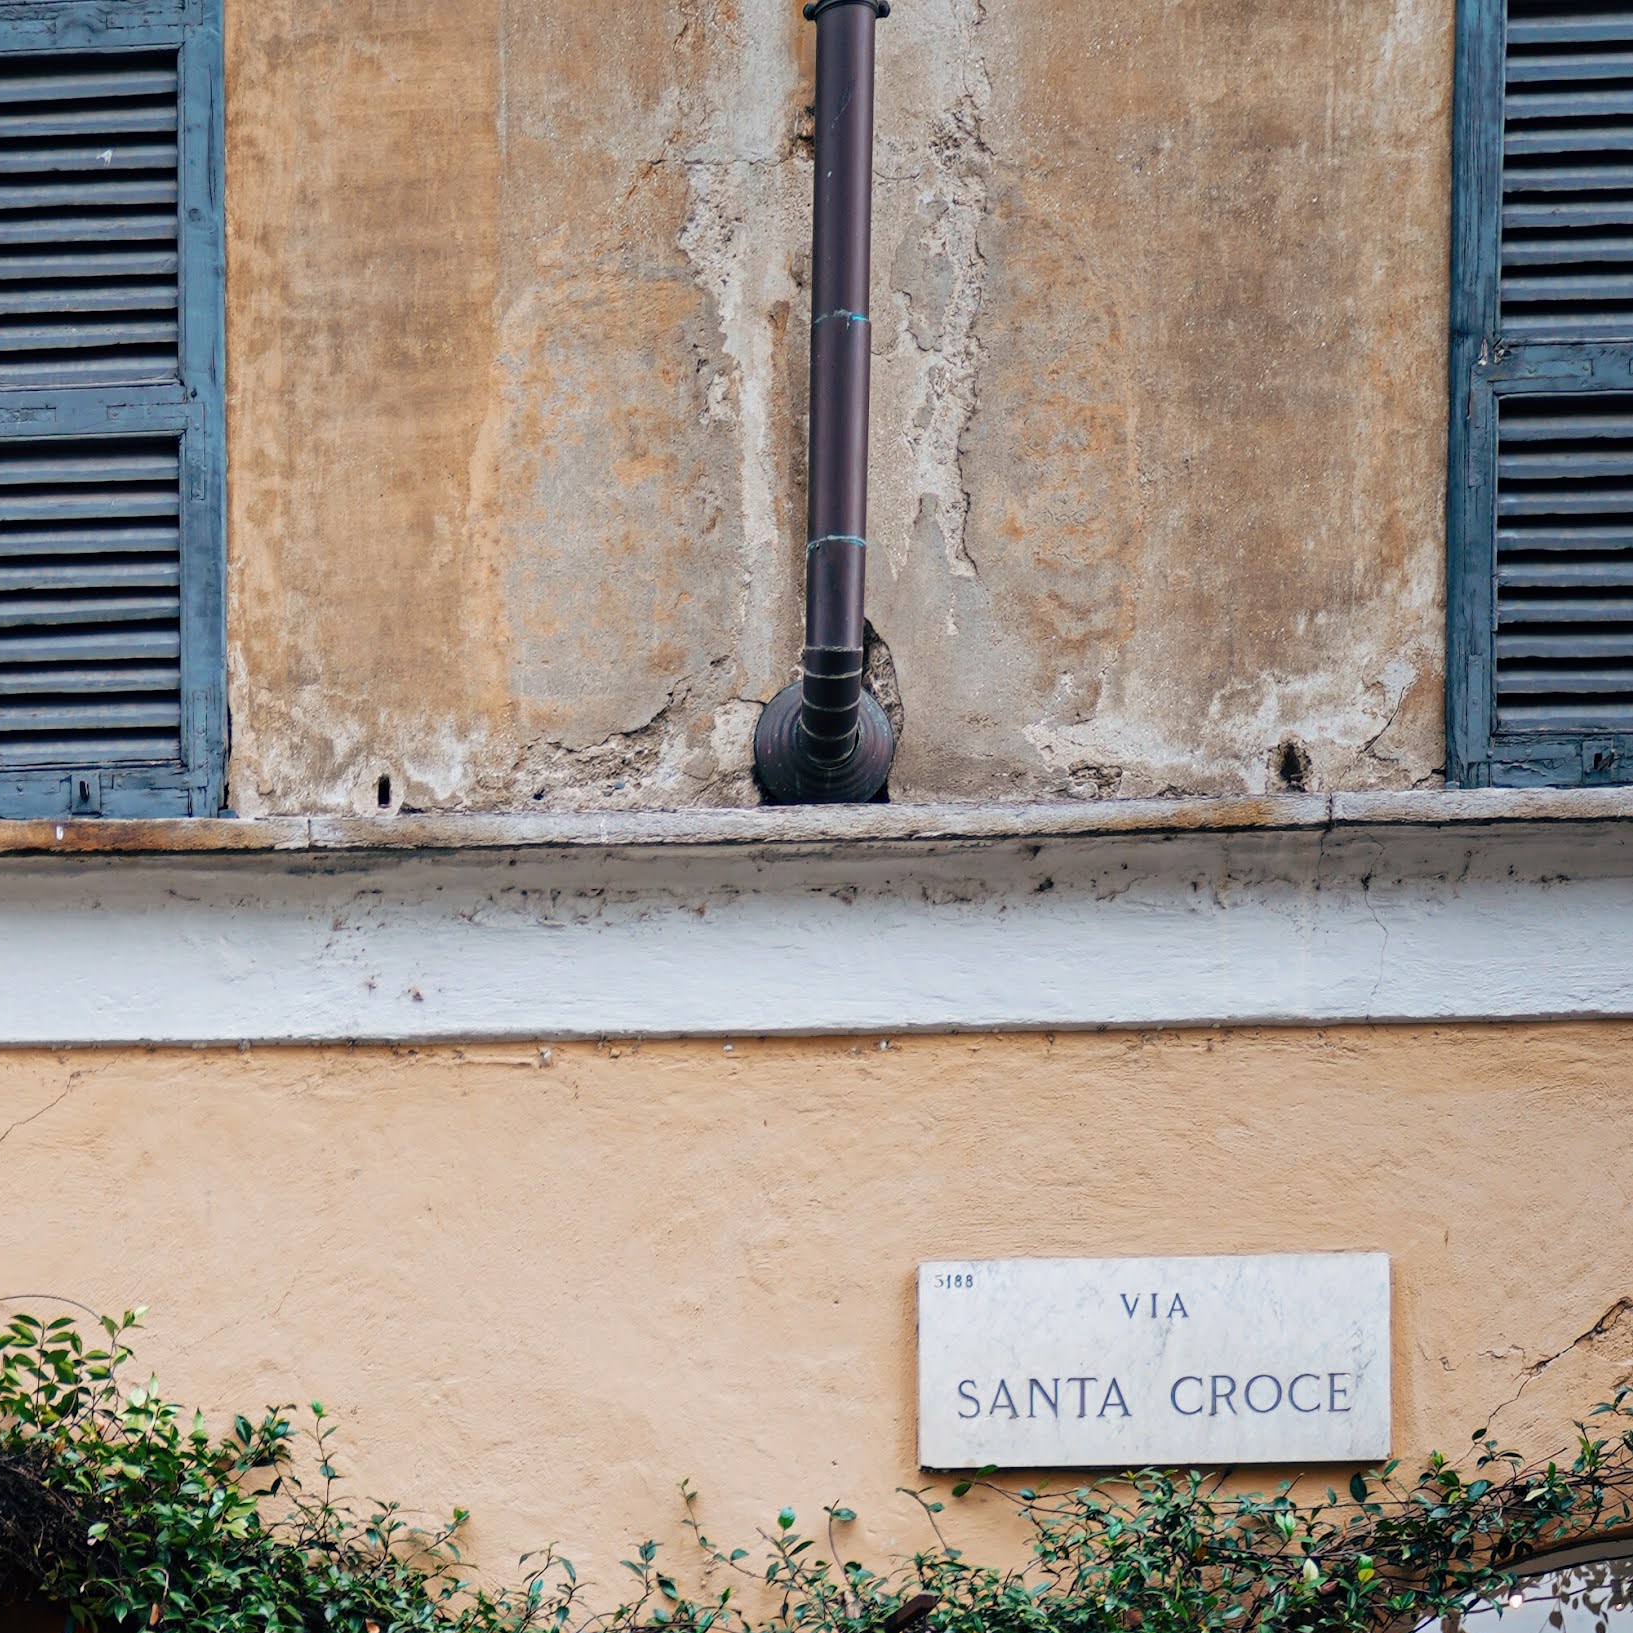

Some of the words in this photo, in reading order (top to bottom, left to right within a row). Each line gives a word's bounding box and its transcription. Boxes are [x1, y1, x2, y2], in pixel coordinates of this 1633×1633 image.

[934, 1273, 974, 1289] 5188
[1120, 1292, 1189, 1319] VIA
[957, 1376, 1132, 1420] SANTA
[1169, 1372, 1352, 1418] CROCE
